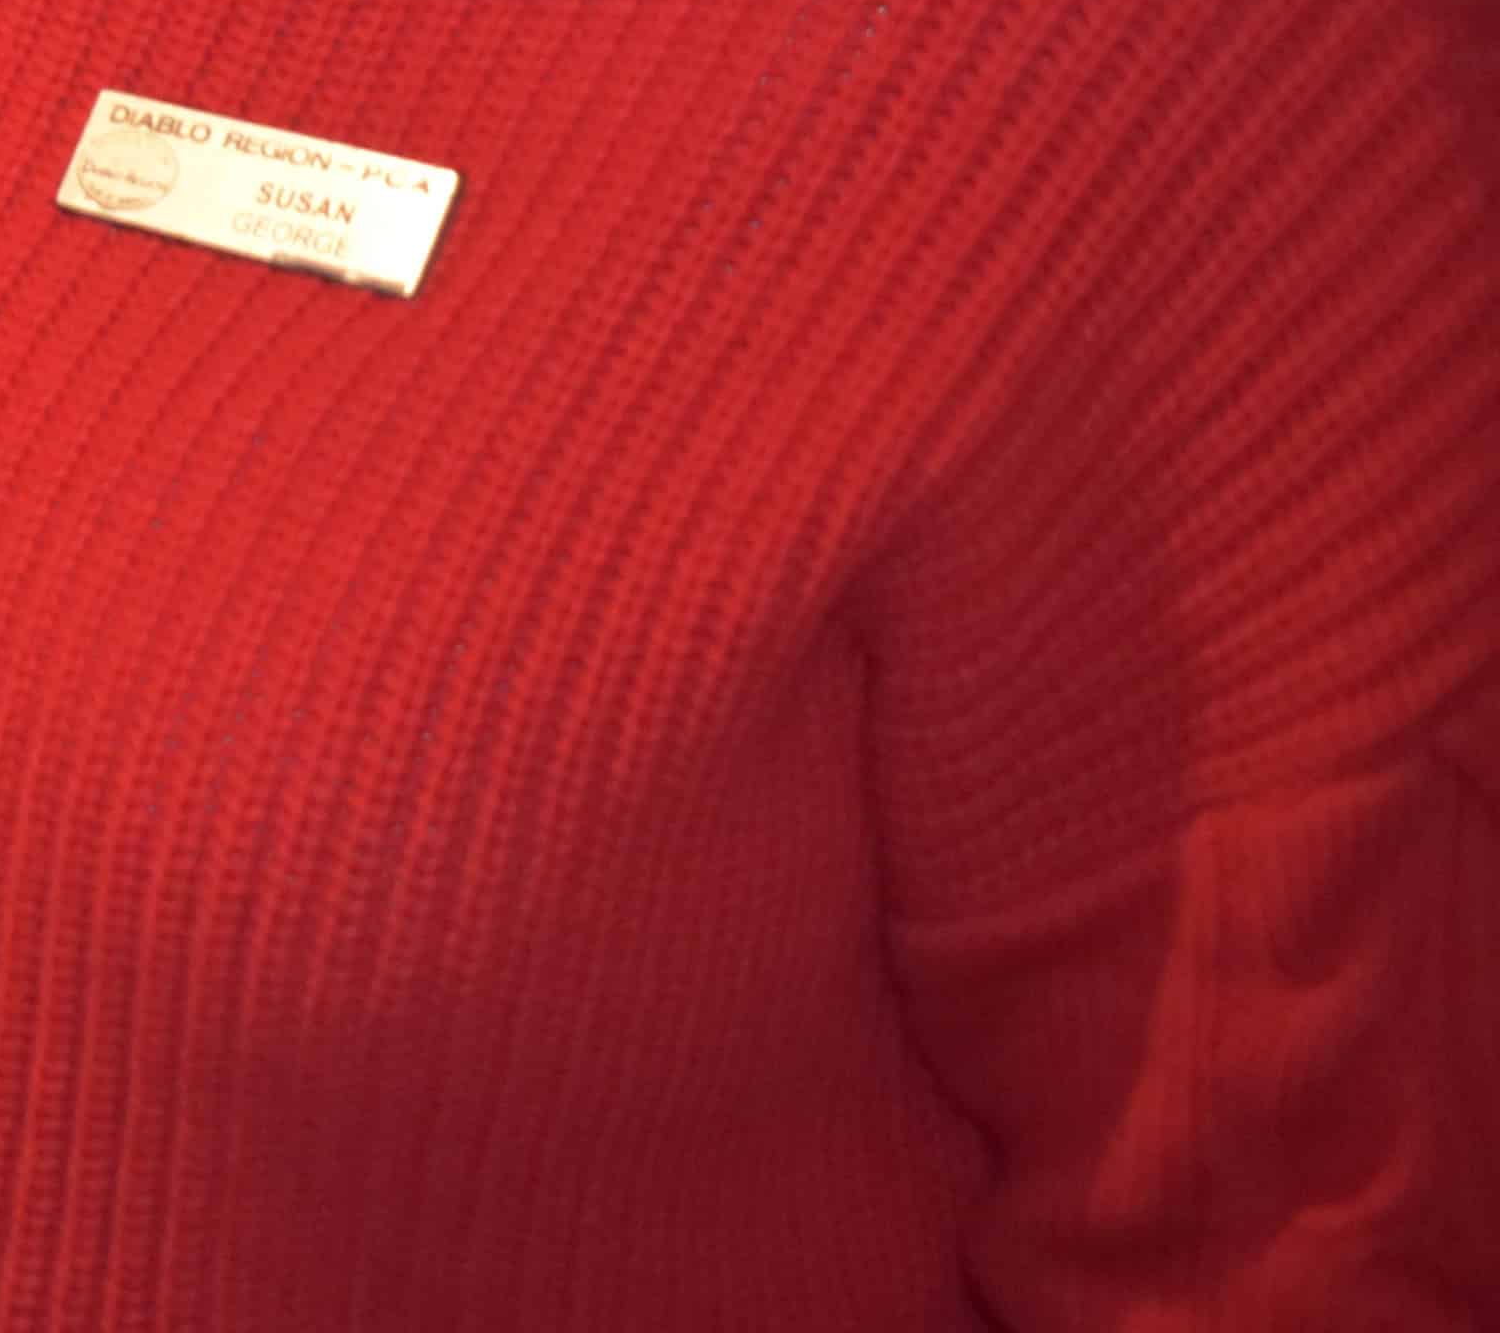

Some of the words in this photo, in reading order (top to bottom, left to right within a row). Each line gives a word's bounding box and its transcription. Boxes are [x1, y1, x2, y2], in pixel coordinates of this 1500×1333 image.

[109, 104, 212, 144] DIABLO
[222, 131, 332, 171] REGION
[257, 181, 356, 225] SUSAN
[231, 210, 349, 258] GEORGE
